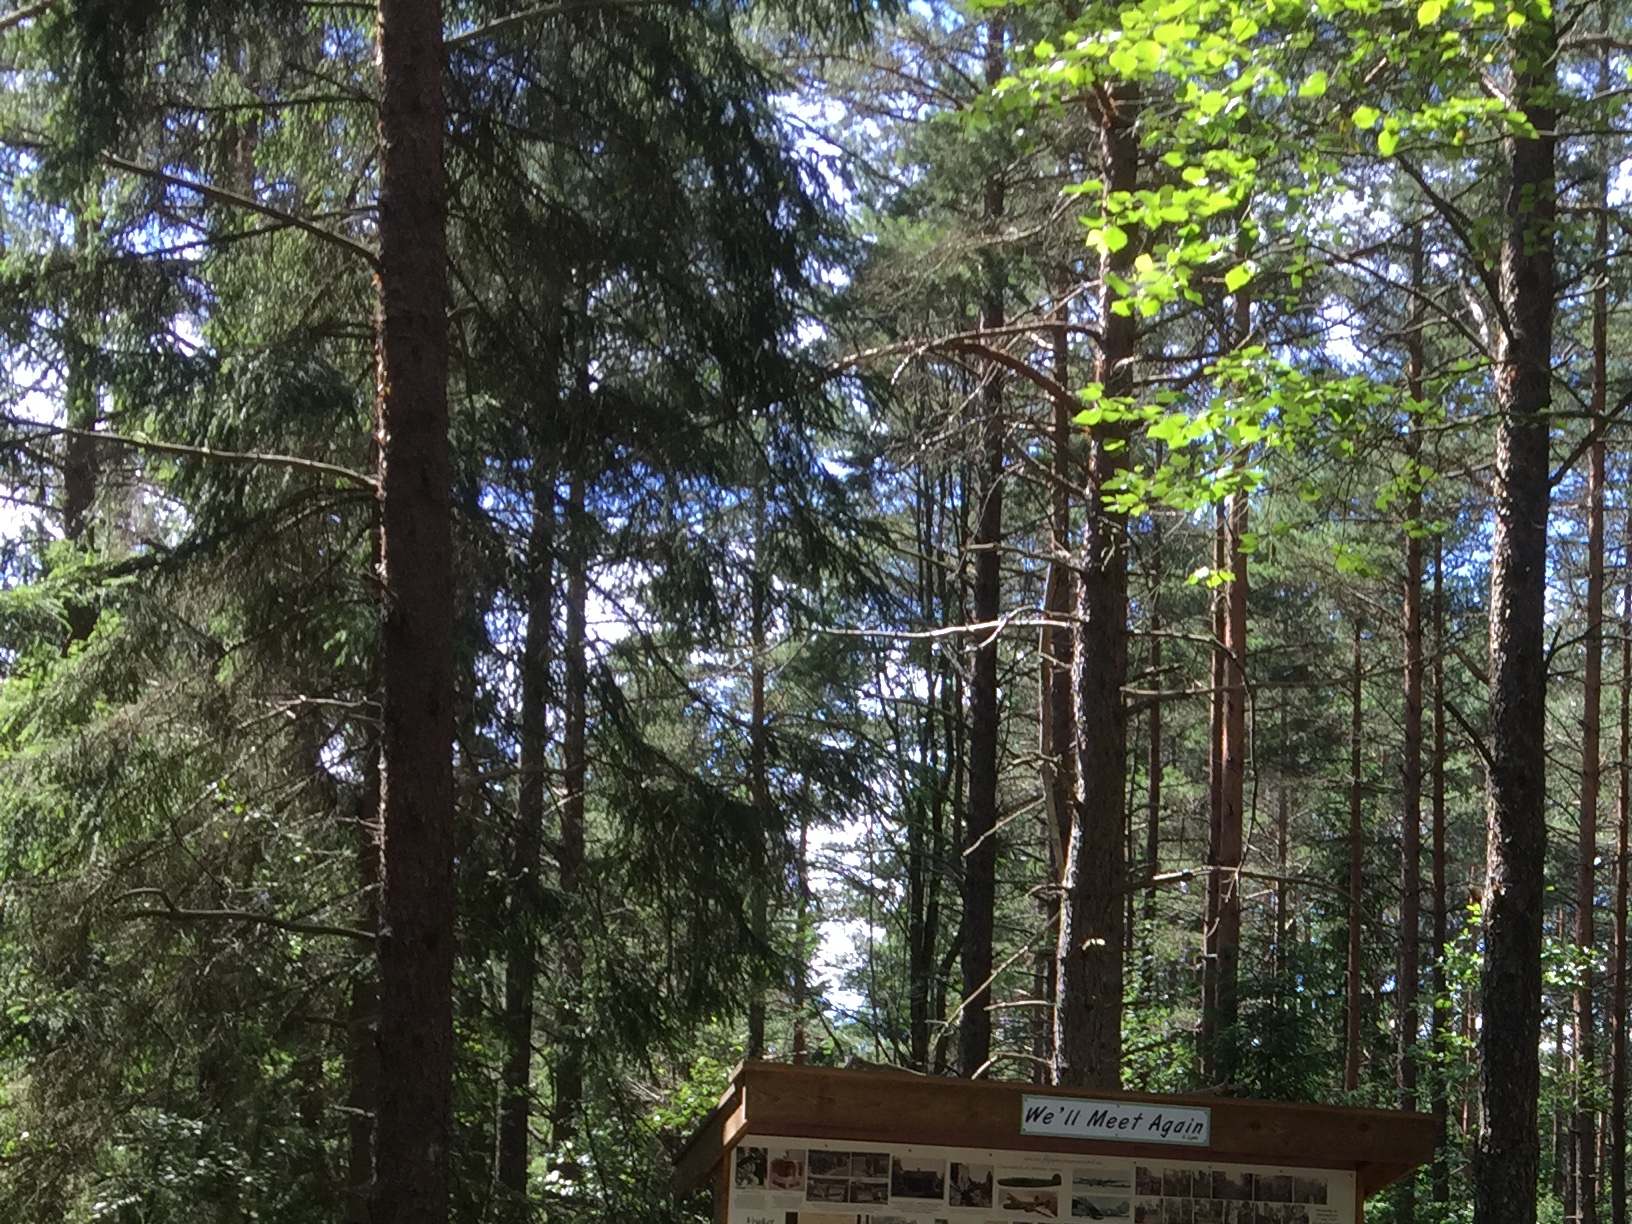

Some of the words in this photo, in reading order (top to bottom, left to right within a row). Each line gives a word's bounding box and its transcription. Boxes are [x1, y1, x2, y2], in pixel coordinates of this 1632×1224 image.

[1025, 1106, 1081, 1126] We'll
[1087, 1110, 1143, 1131] Meet
[1148, 1113, 1204, 1138] Again
